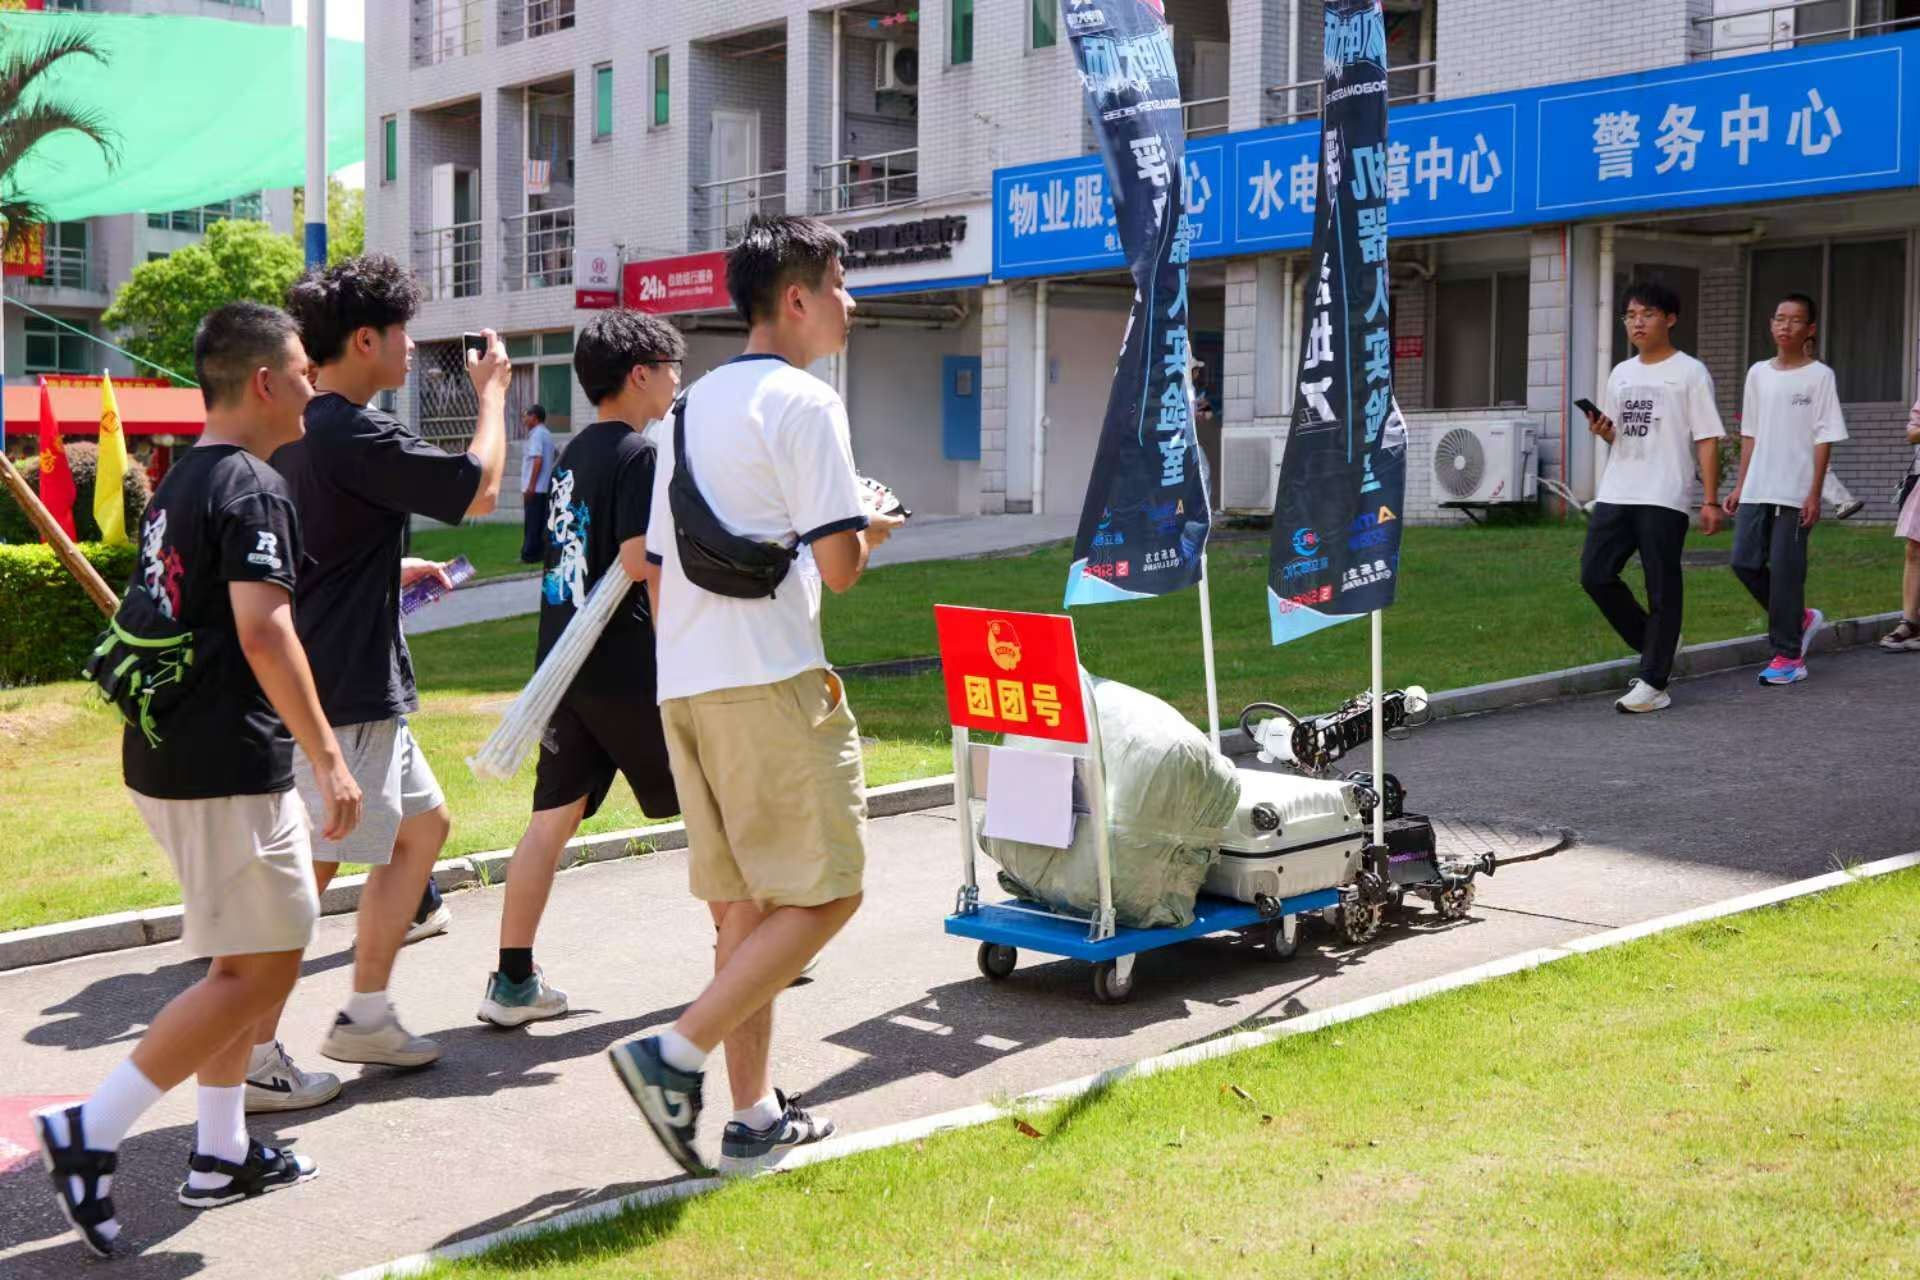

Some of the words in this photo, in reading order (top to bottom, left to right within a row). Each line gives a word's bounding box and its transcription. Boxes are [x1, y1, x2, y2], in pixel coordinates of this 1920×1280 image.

[1591, 88, 1842, 182] 警务中心
[1008, 160, 1212, 238] 物业服心
[1248, 133, 1502, 221] 水电障中心
[640, 275, 667, 302] 24h
[963, 675, 1063, 727] 团团号
